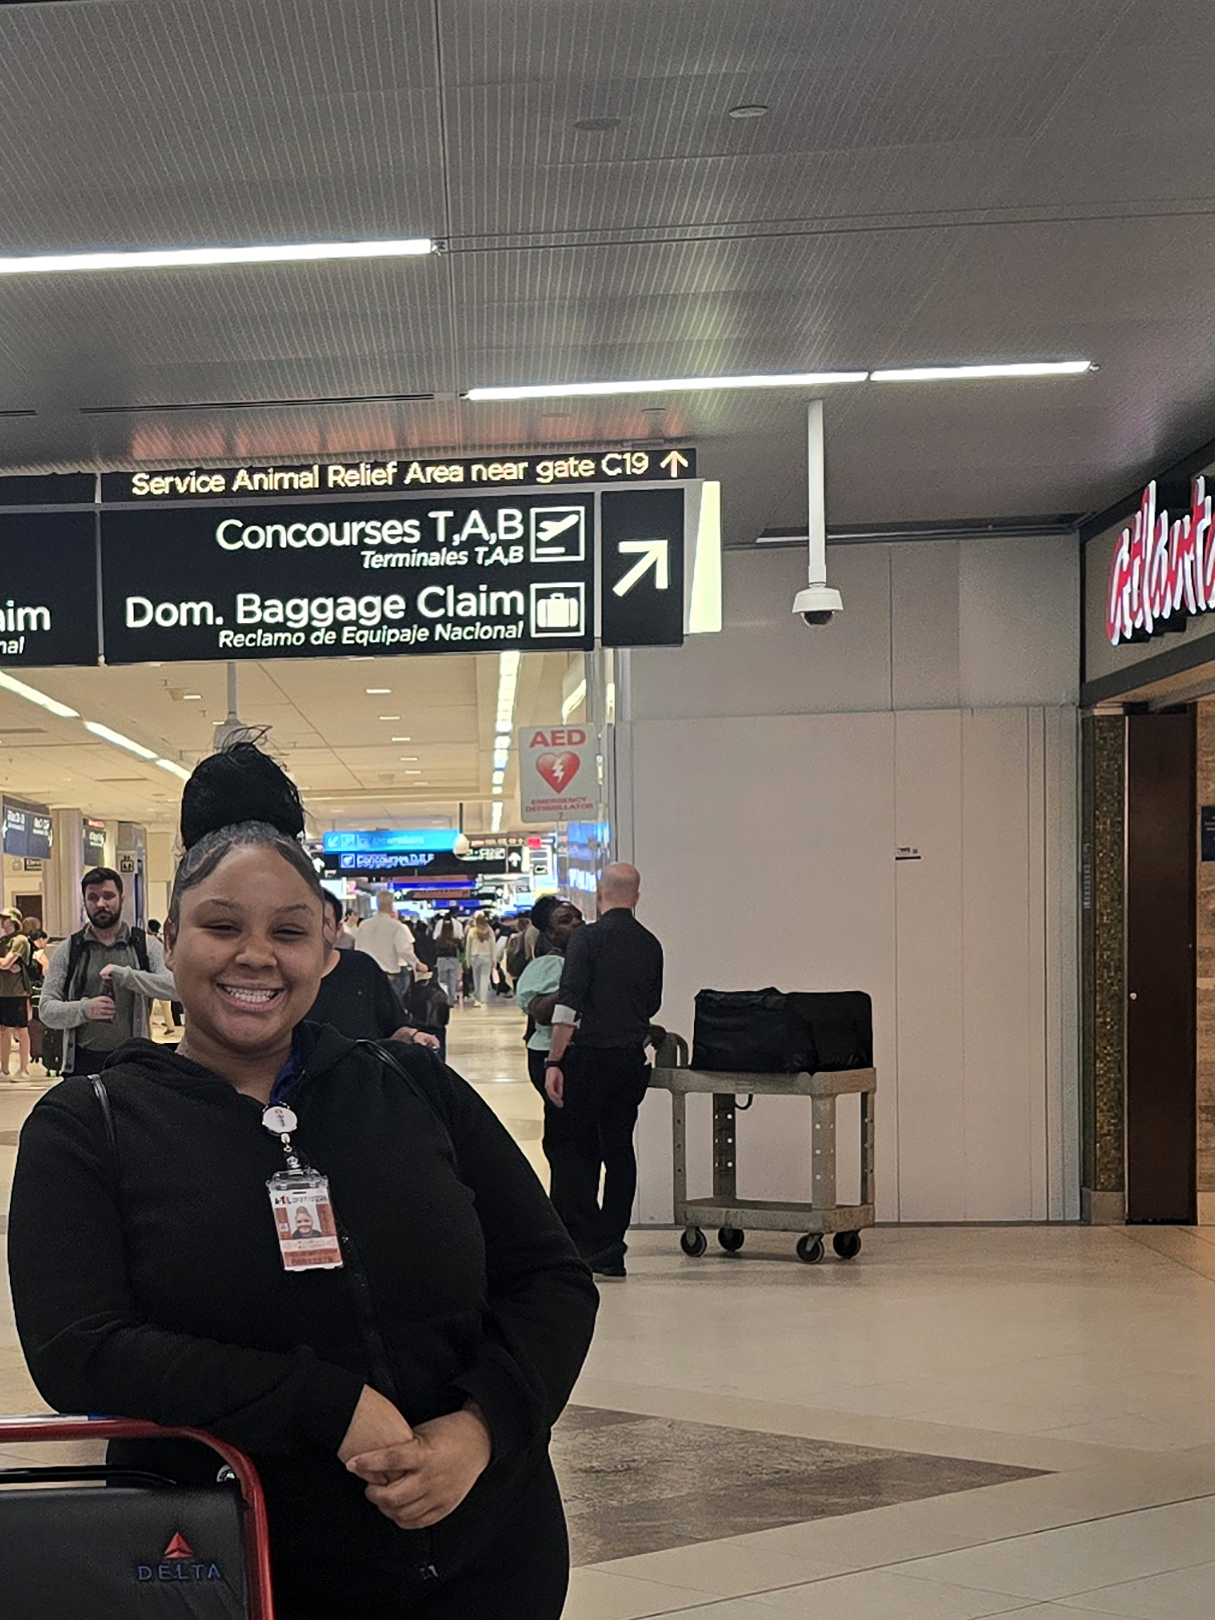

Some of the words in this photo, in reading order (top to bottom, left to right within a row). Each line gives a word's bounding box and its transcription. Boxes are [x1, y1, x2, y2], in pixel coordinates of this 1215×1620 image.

[132, 467, 226, 496] Service
[232, 463, 320, 492] Animal
[328, 459, 399, 488] Relief
[404, 461, 465, 485] Area
[471, 462, 531, 483] near
[536, 457, 596, 484] gate
[601, 452, 649, 476] C19
[216, 518, 421, 551] Concourses
[428, 509, 525, 546] T,A,B
[361, 550, 469, 569] Terminales
[475, 545, 525, 567] T,A,B
[126, 597, 224, 628] Dom.
[237, 592, 406, 629] Baggage
[417, 585, 525, 619] Claim
[219, 629, 306, 648] Reclamo
[310, 628, 337, 646] de
[342, 624, 430, 645] Equipaje
[435, 621, 525, 641] Nacional
[529, 729, 587, 748] AED
[525, 803, 594, 813] DEFIBRILLATOR
[531, 797, 588, 805] EMERGENCY
[137, 1563, 221, 1580] DELTA
